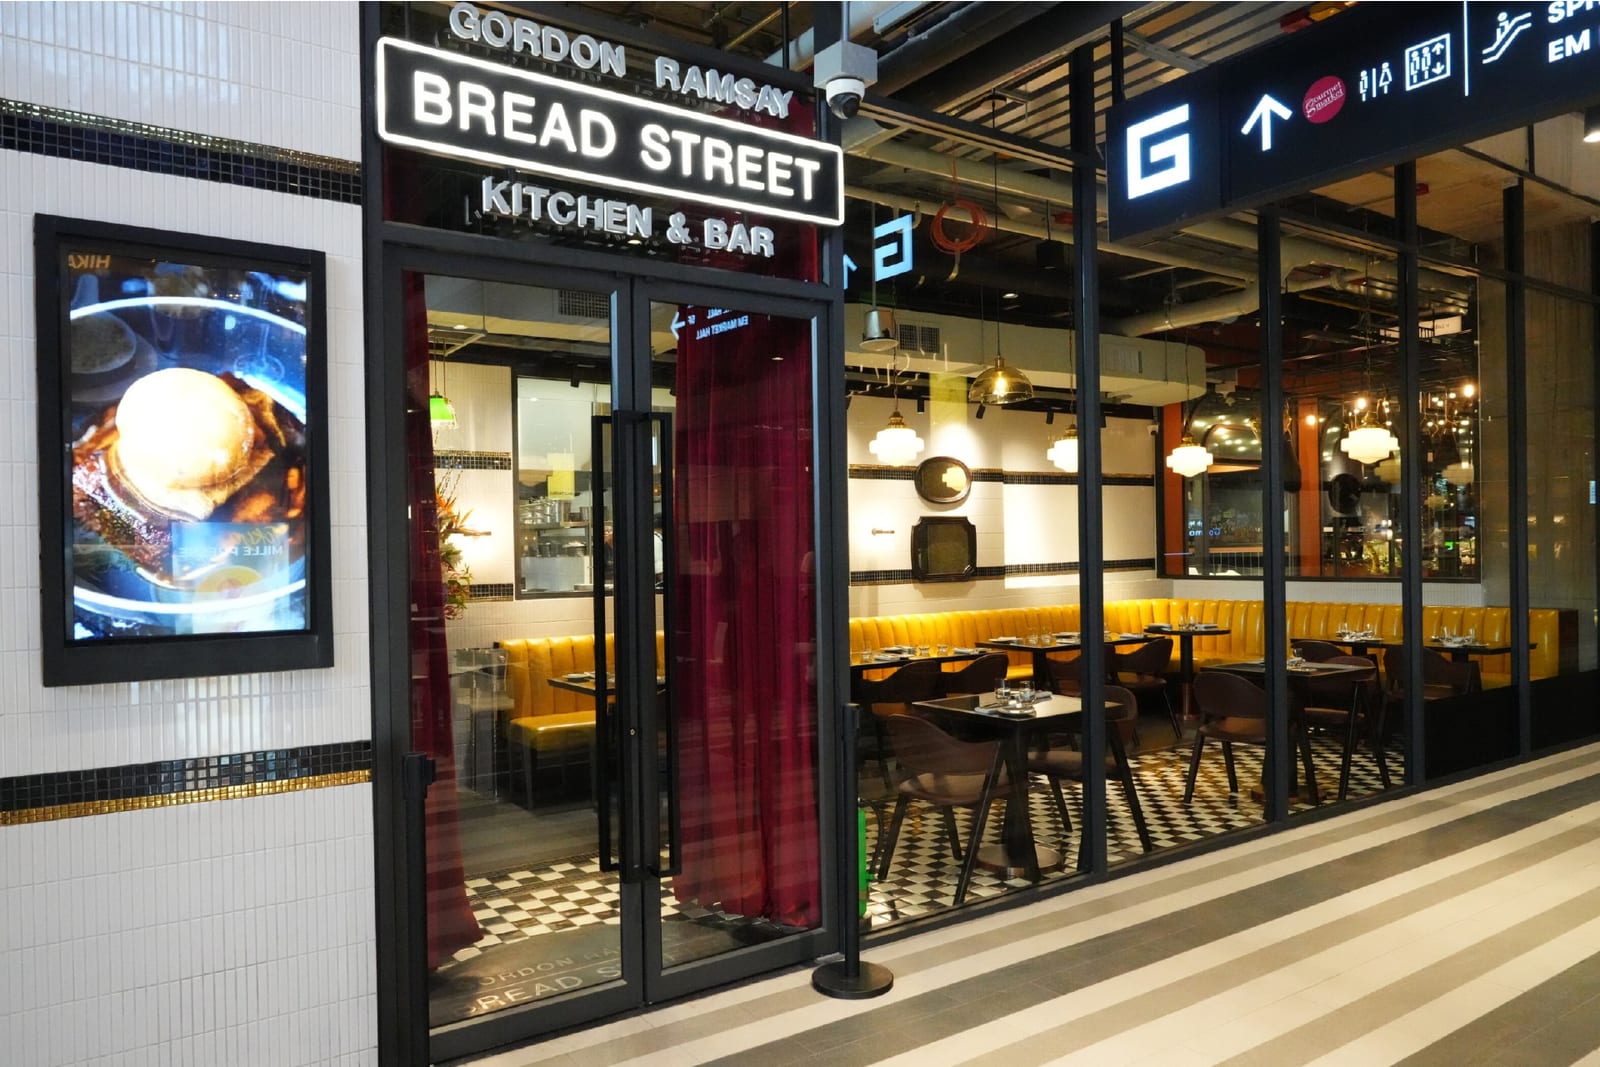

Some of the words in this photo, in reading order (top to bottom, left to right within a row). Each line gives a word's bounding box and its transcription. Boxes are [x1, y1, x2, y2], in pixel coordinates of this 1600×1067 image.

[449, 2, 627, 78] GORDON
[655, 56, 793, 119] RAMSAY
[1548, 28, 1591, 64] EM
[414, 70, 617, 158] BREAD
[640, 123, 821, 201] STREET
[1127, 103, 1191, 200] G
[482, 176, 652, 238] KITCHEN
[666, 211, 691, 244] &
[704, 217, 775, 258] BAR
